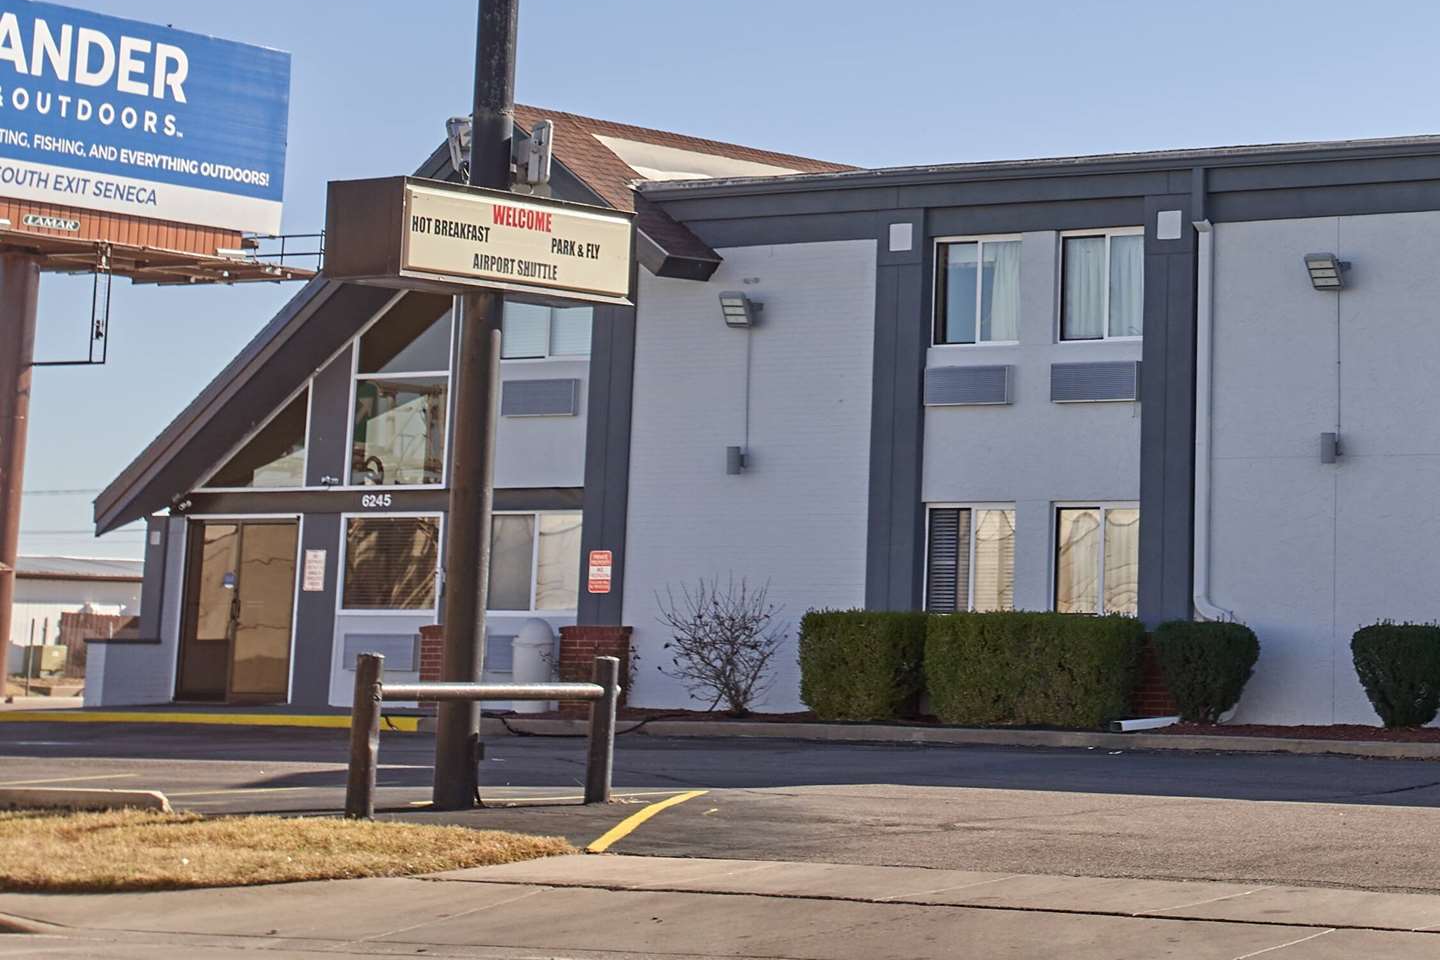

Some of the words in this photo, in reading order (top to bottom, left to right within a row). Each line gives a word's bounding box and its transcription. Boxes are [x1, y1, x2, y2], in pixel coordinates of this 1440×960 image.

[12, 87, 177, 137] OUTDOORS
[88, 144, 117, 161] AND
[120, 148, 198, 174] EVERYTHING
[200, 162, 269, 187] OUTDOORS!
[0, 166, 50, 189] OUTH
[53, 174, 90, 195] EXIT
[93, 180, 157, 206] SENECA
[27, 215, 76, 230] LAMAR
[412, 215, 432, 234] HOT
[434, 218, 490, 243] BREAKFAST
[493, 204, 552, 233] WELCOME
[551, 237, 575, 257] PARK
[577, 243, 584, 258] &
[586, 243, 600, 260] FLY
[473, 252, 515, 275] AIRPORT
[518, 259, 557, 281] SHUTTLE
[361, 494, 392, 507] 6245
